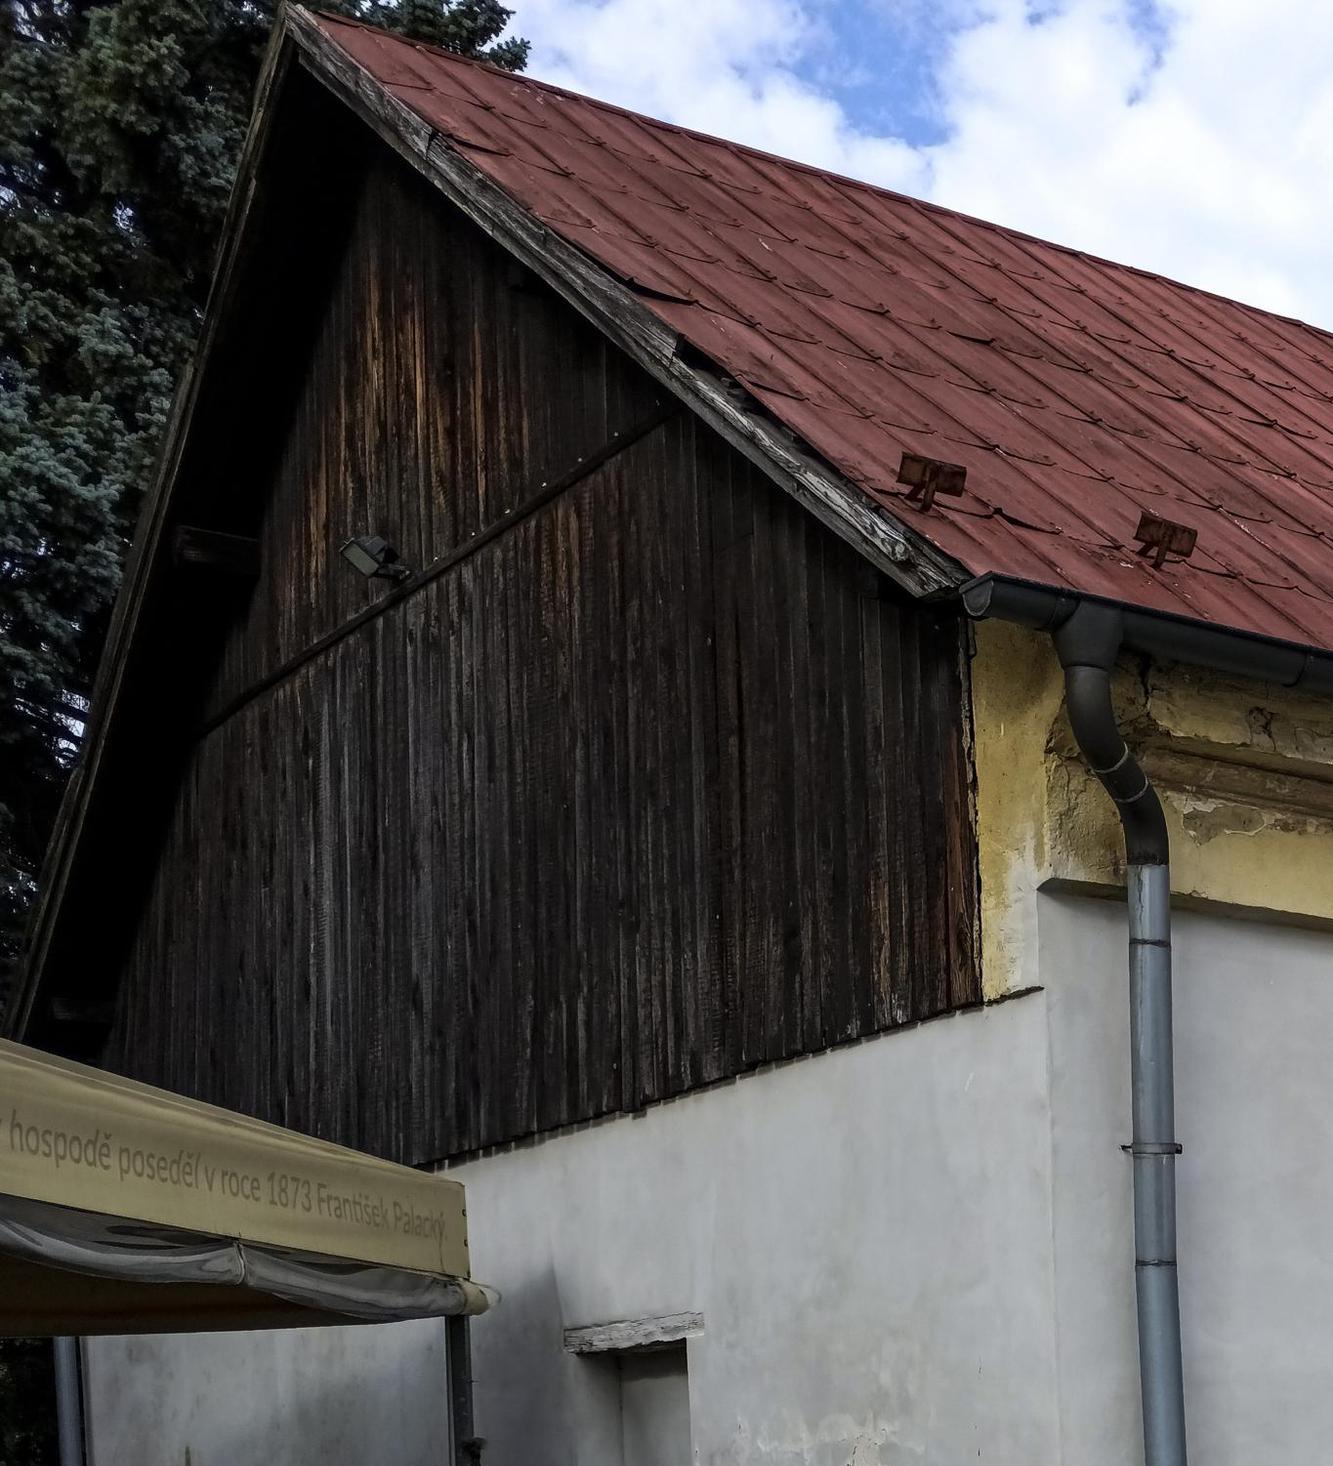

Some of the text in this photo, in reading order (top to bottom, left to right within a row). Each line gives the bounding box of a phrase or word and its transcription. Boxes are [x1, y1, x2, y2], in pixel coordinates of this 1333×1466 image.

[10, 1109, 112, 1171] hospodě
[119, 1146, 201, 1190] poseděl
[204, 1165, 216, 1192] v
[221, 1169, 261, 1202] roce
[267, 1172, 312, 1213] 1873
[317, 1183, 389, 1229] František
